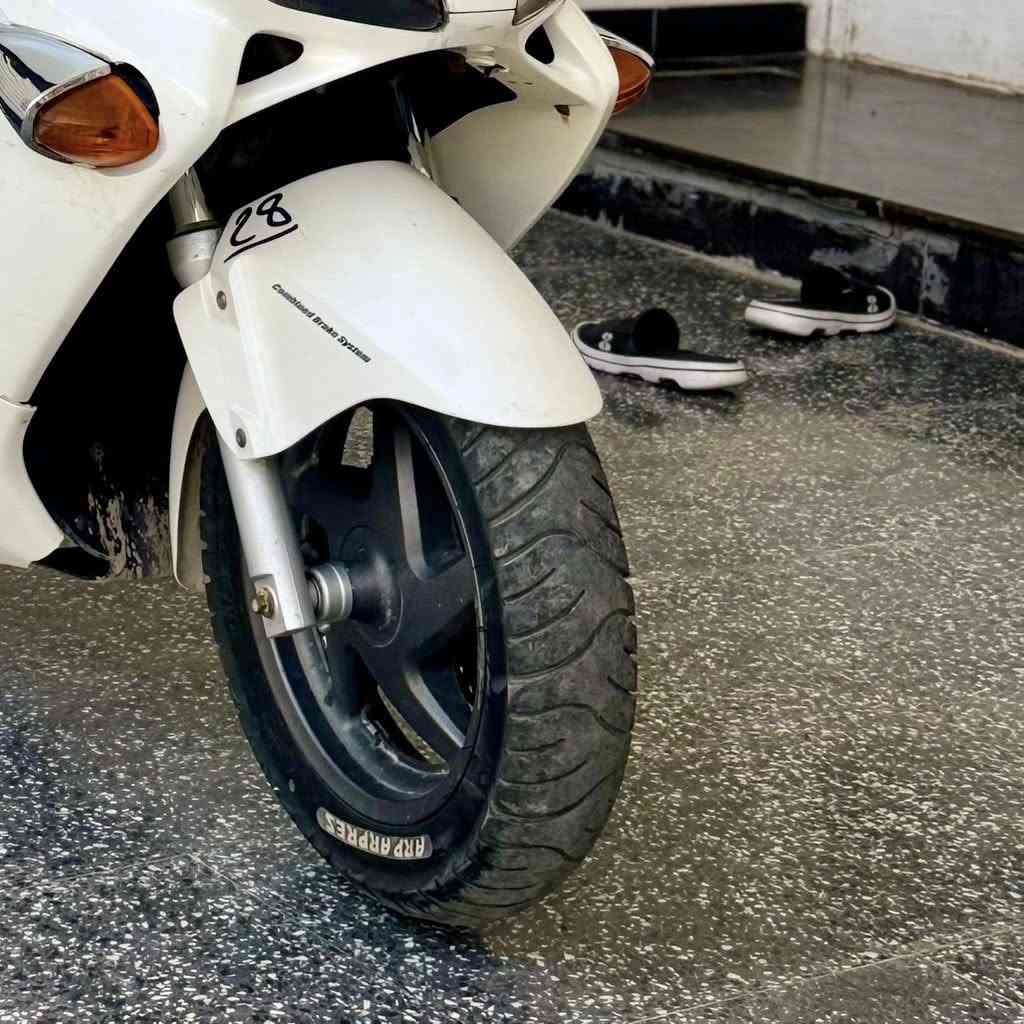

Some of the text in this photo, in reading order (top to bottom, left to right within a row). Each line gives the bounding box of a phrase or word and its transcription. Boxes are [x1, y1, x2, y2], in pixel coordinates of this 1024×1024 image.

[229, 192, 293, 247] 28
[312, 315, 339, 339] Brake
[337, 335, 372, 363] System
